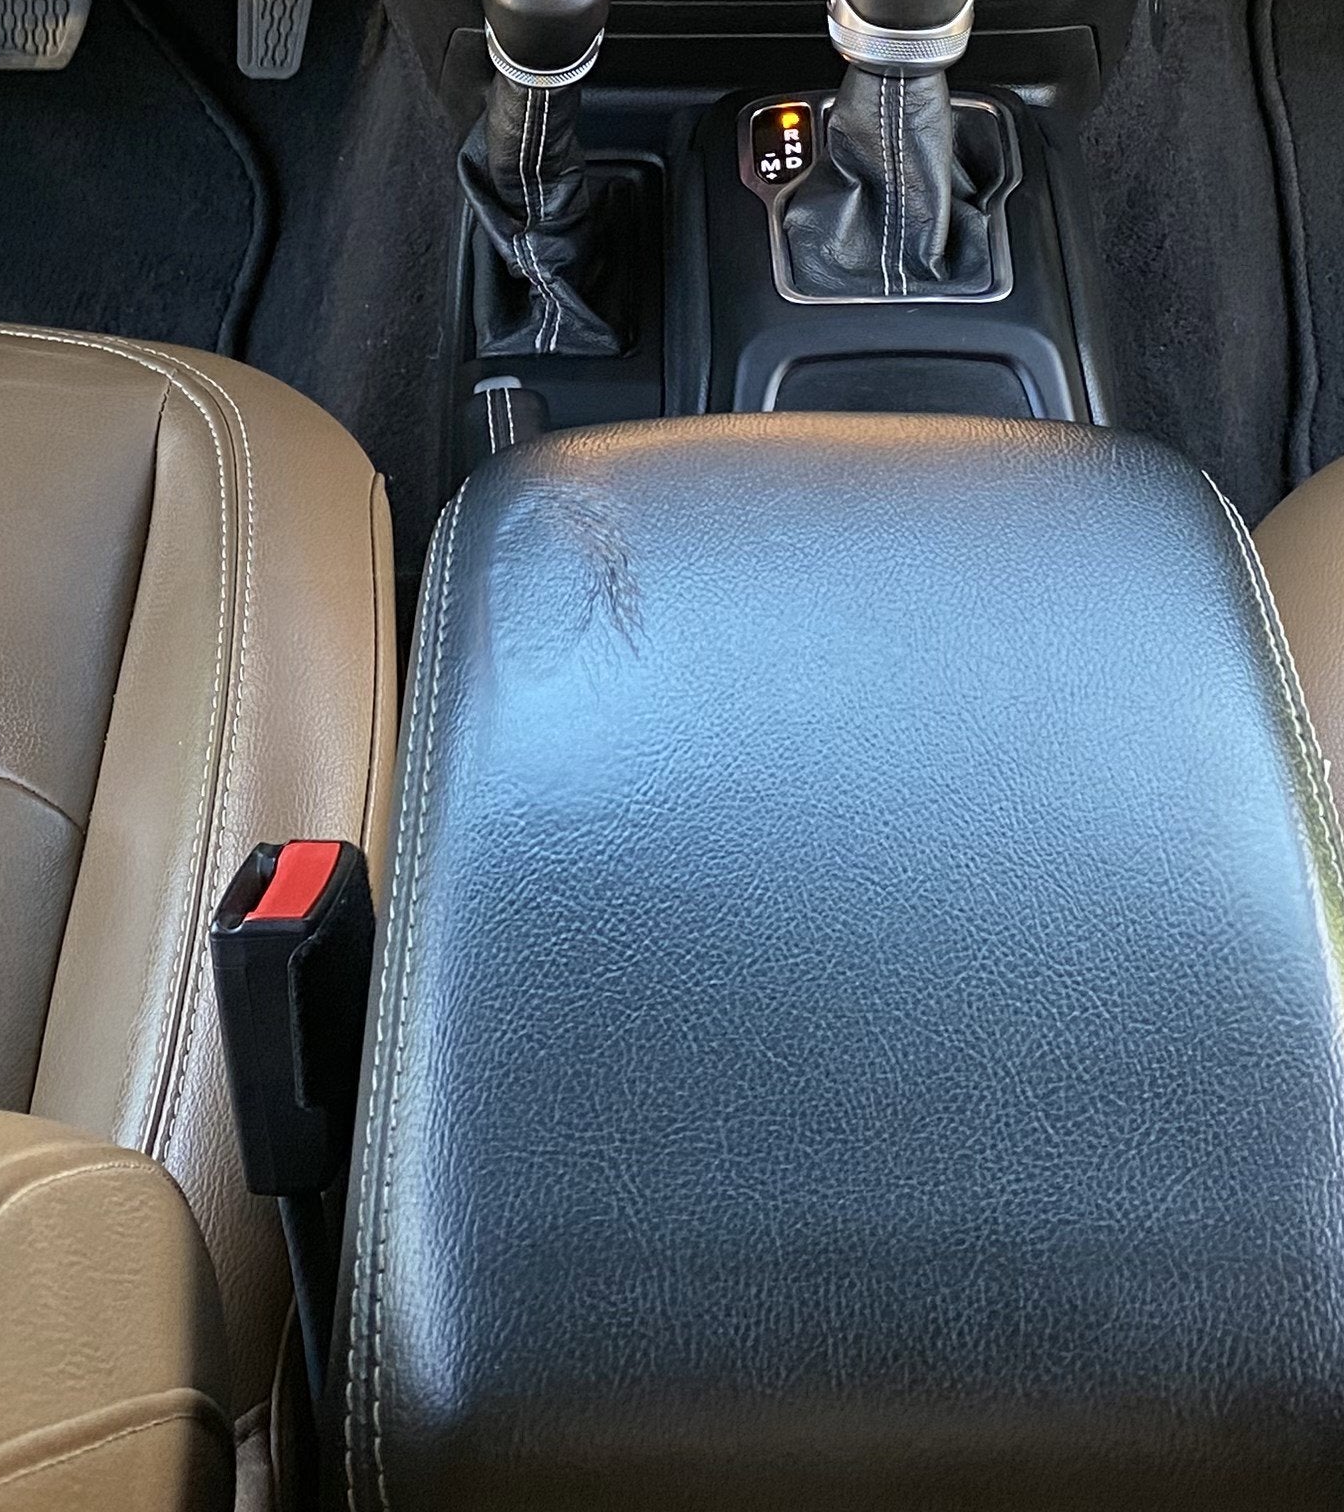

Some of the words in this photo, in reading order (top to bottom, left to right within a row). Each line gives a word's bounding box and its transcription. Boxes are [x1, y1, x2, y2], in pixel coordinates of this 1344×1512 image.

[782, 112, 799, 128] P
[783, 128, 799, 141] R
[784, 142, 802, 155] N
[760, 158, 781, 172] M
[785, 156, 803, 169] D
